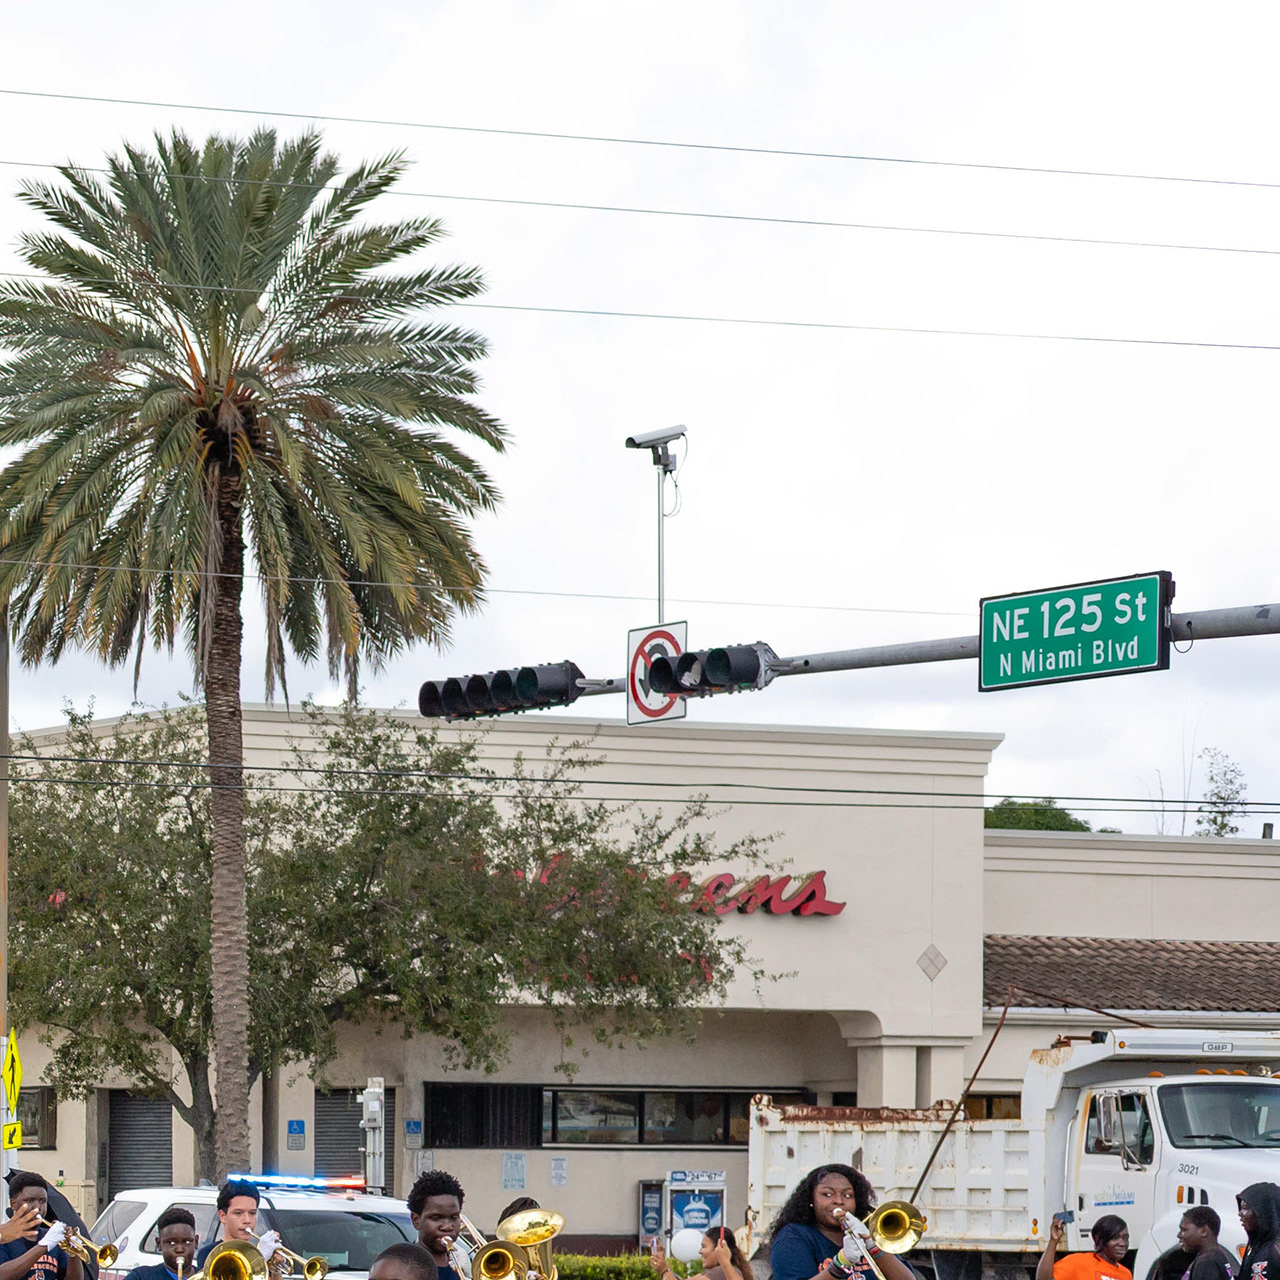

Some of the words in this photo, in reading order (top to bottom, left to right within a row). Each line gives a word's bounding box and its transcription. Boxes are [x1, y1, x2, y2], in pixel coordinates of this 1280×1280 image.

[992, 607, 1029, 643] NE
[1040, 593, 1102, 638] 125
[1114, 591, 1147, 625] St
[1000, 652, 1012, 677] N
[1022, 643, 1082, 674] Miami
[1092, 635, 1138, 665] Blvd
[1178, 1163, 1199, 1175] 3021
